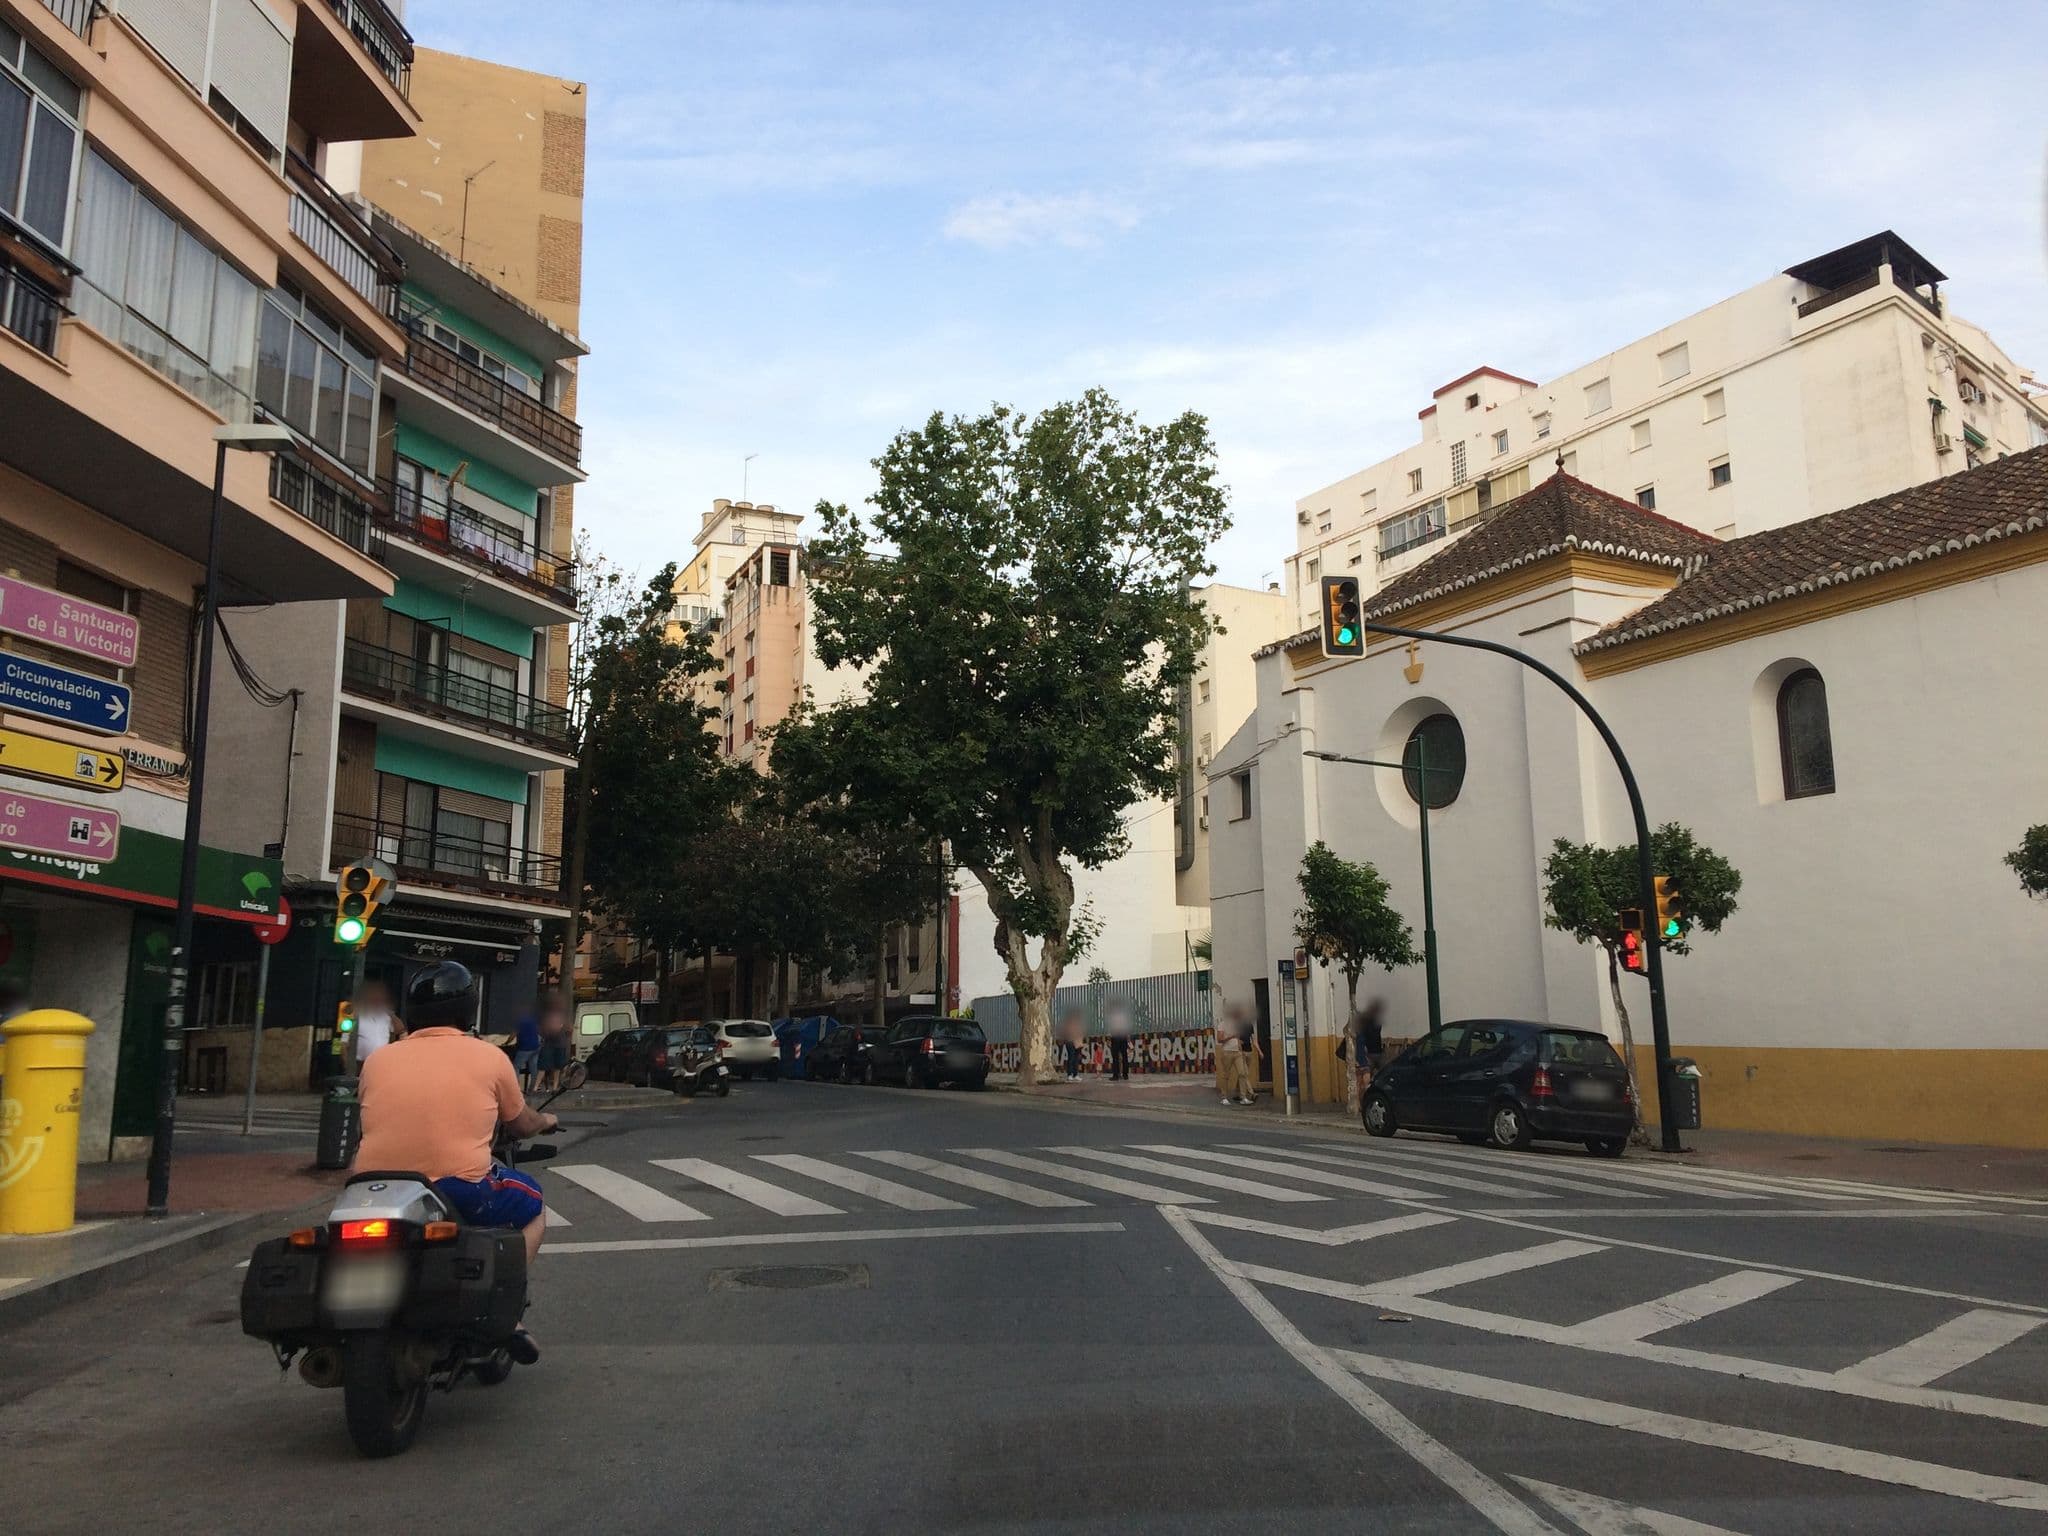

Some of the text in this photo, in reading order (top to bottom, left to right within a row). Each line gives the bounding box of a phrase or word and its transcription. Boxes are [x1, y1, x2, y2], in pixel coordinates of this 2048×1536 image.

[60, 603, 134, 639] Santuario
[27, 614, 132, 658] de la Victoria
[0, 682, 72, 711] direcciones
[6, 664, 101, 701] Circunvalación
[5, 801, 26, 818] de
[0, 822, 17, 837] ro
[1149, 1034, 1217, 1062] GRACIA
